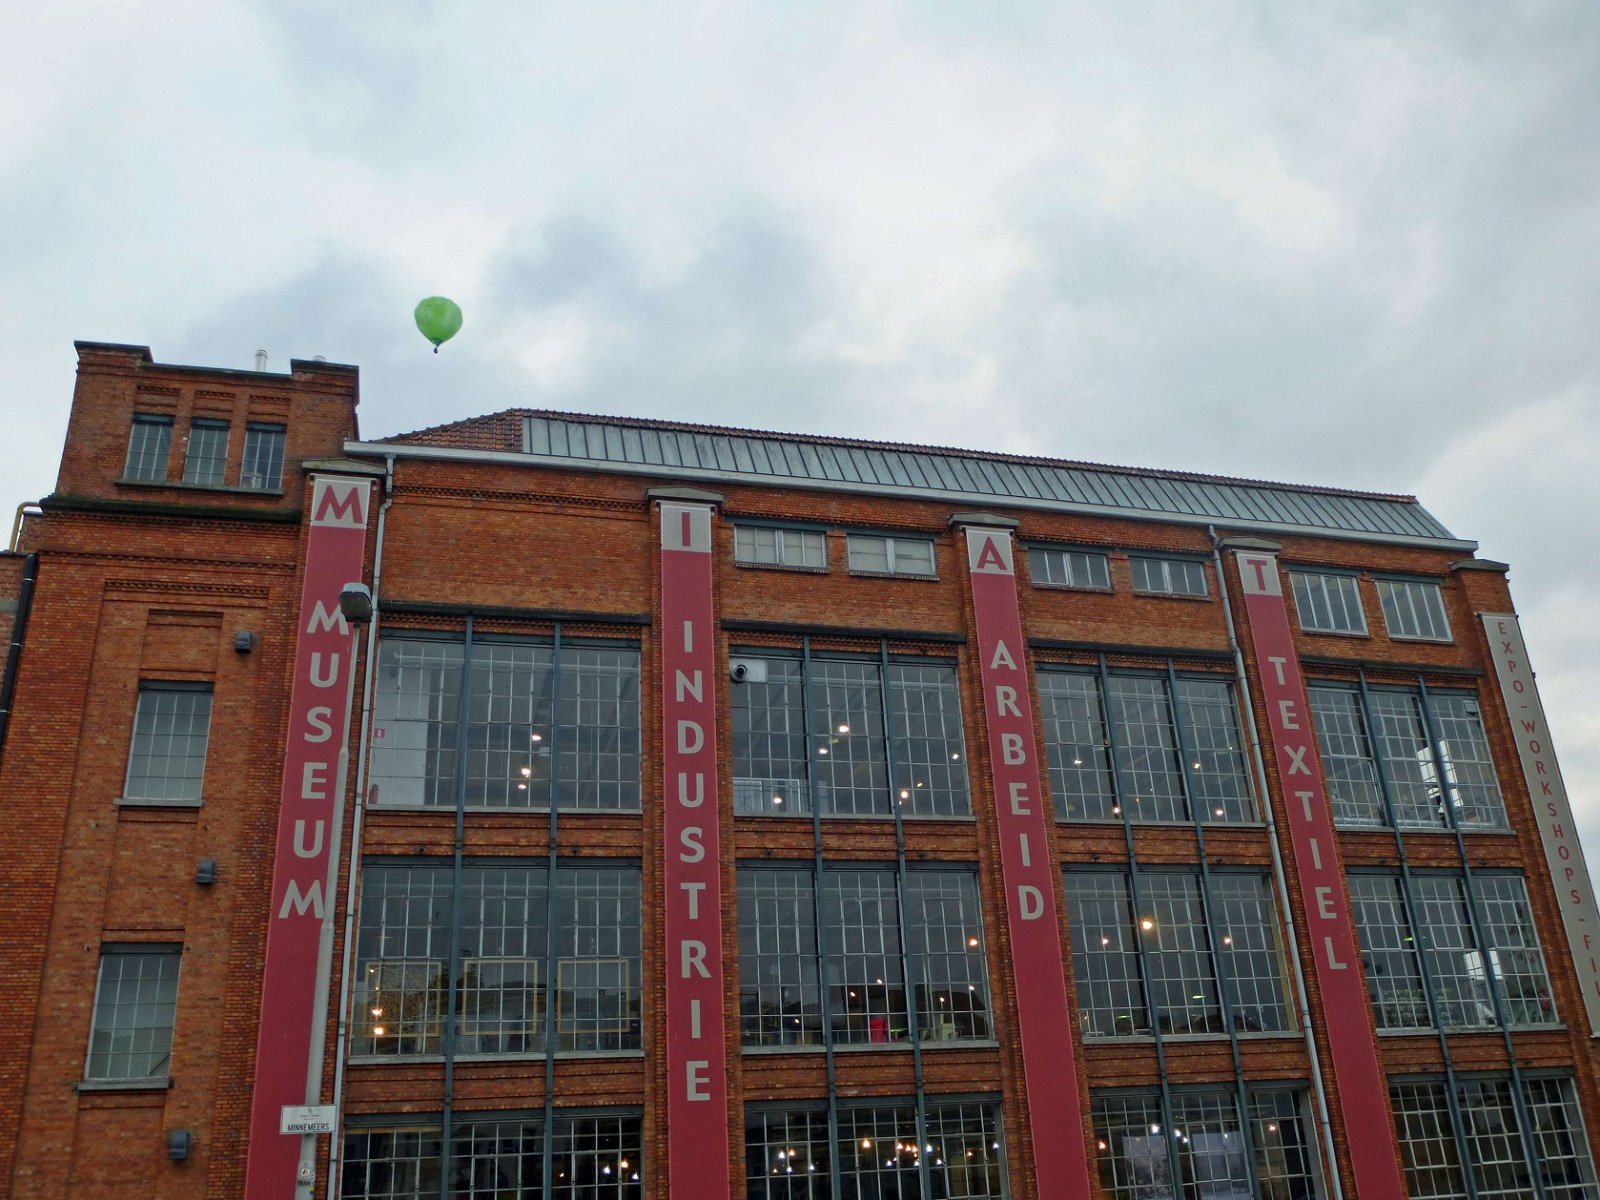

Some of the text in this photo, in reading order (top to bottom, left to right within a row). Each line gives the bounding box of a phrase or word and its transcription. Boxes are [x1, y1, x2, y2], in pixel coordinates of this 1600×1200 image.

[314, 484, 364, 525] M
[681, 511, 691, 547] I
[976, 536, 1008, 571] A
[1246, 559, 1268, 591] T
[278, 600, 350, 919] MUSEUM
[990, 639, 1045, 921] ARBEID
[1268, 656, 1347, 971] TEXTIEL
[676, 620, 711, 1102] INDUSTRIE
[287, 1122, 330, 1132] MINNEMEERS
